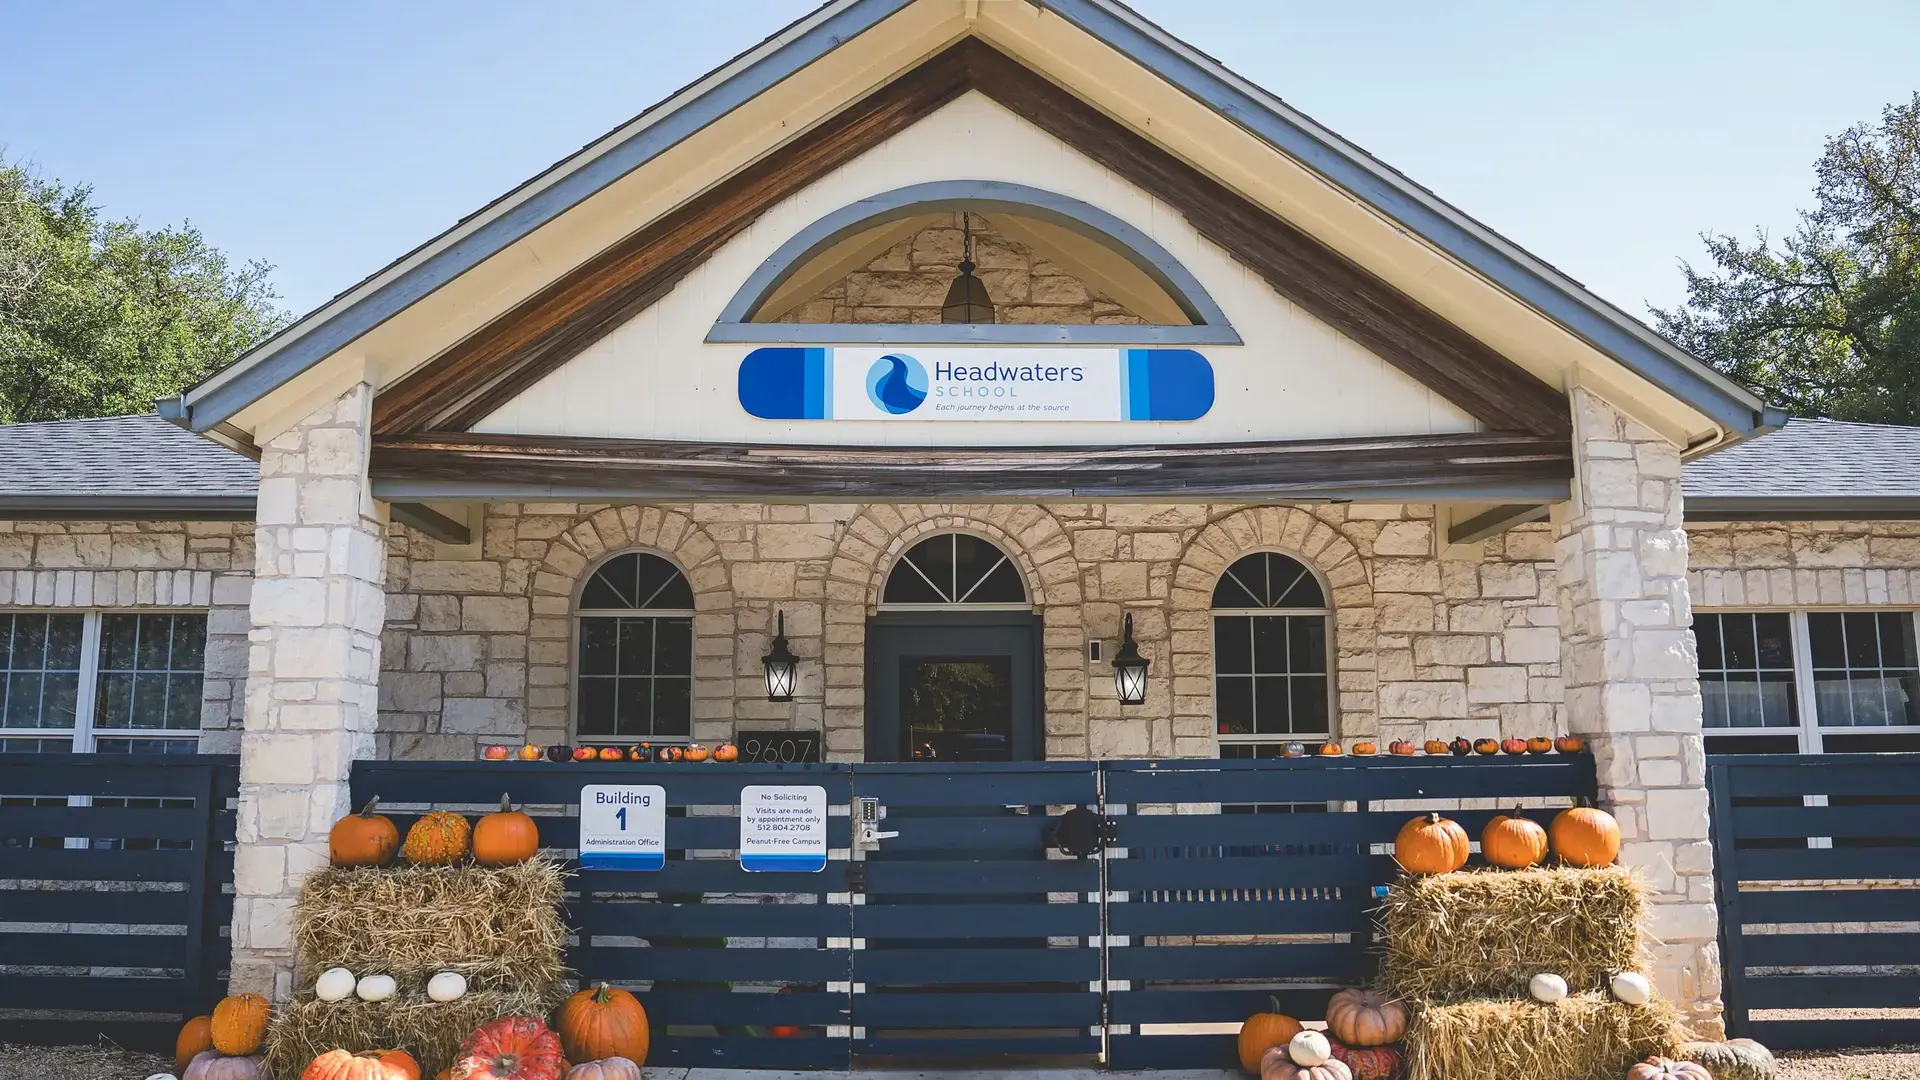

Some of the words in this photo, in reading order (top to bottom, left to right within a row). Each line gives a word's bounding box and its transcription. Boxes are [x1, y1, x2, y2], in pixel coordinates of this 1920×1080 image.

[935, 361, 1084, 382] Headwaters
[935, 386, 1018, 397] SCHOOL
[935, 403, 955, 411] Each
[957, 403, 986, 413] journey
[988, 403, 1014, 413] begins
[1027, 403, 1041, 411] the
[745, 739, 812, 764] 9607
[595, 791, 651, 806] Building
[760, 793, 772, 801] No
[774, 793, 808, 803] Soliciting
[755, 807, 777, 815] Visits
[793, 807, 813, 815] made
[615, 807, 627, 831] 1
[746, 815, 755, 824] by
[758, 816, 803, 825] appointment
[805, 815, 821, 824] only
[757, 824, 811, 832] 512.804.2708
[585, 838, 636, 846] Administration
[637, 838, 660, 846] Office
[746, 837, 790, 846] Peanut-Free
[791, 837, 821, 847] Campus
